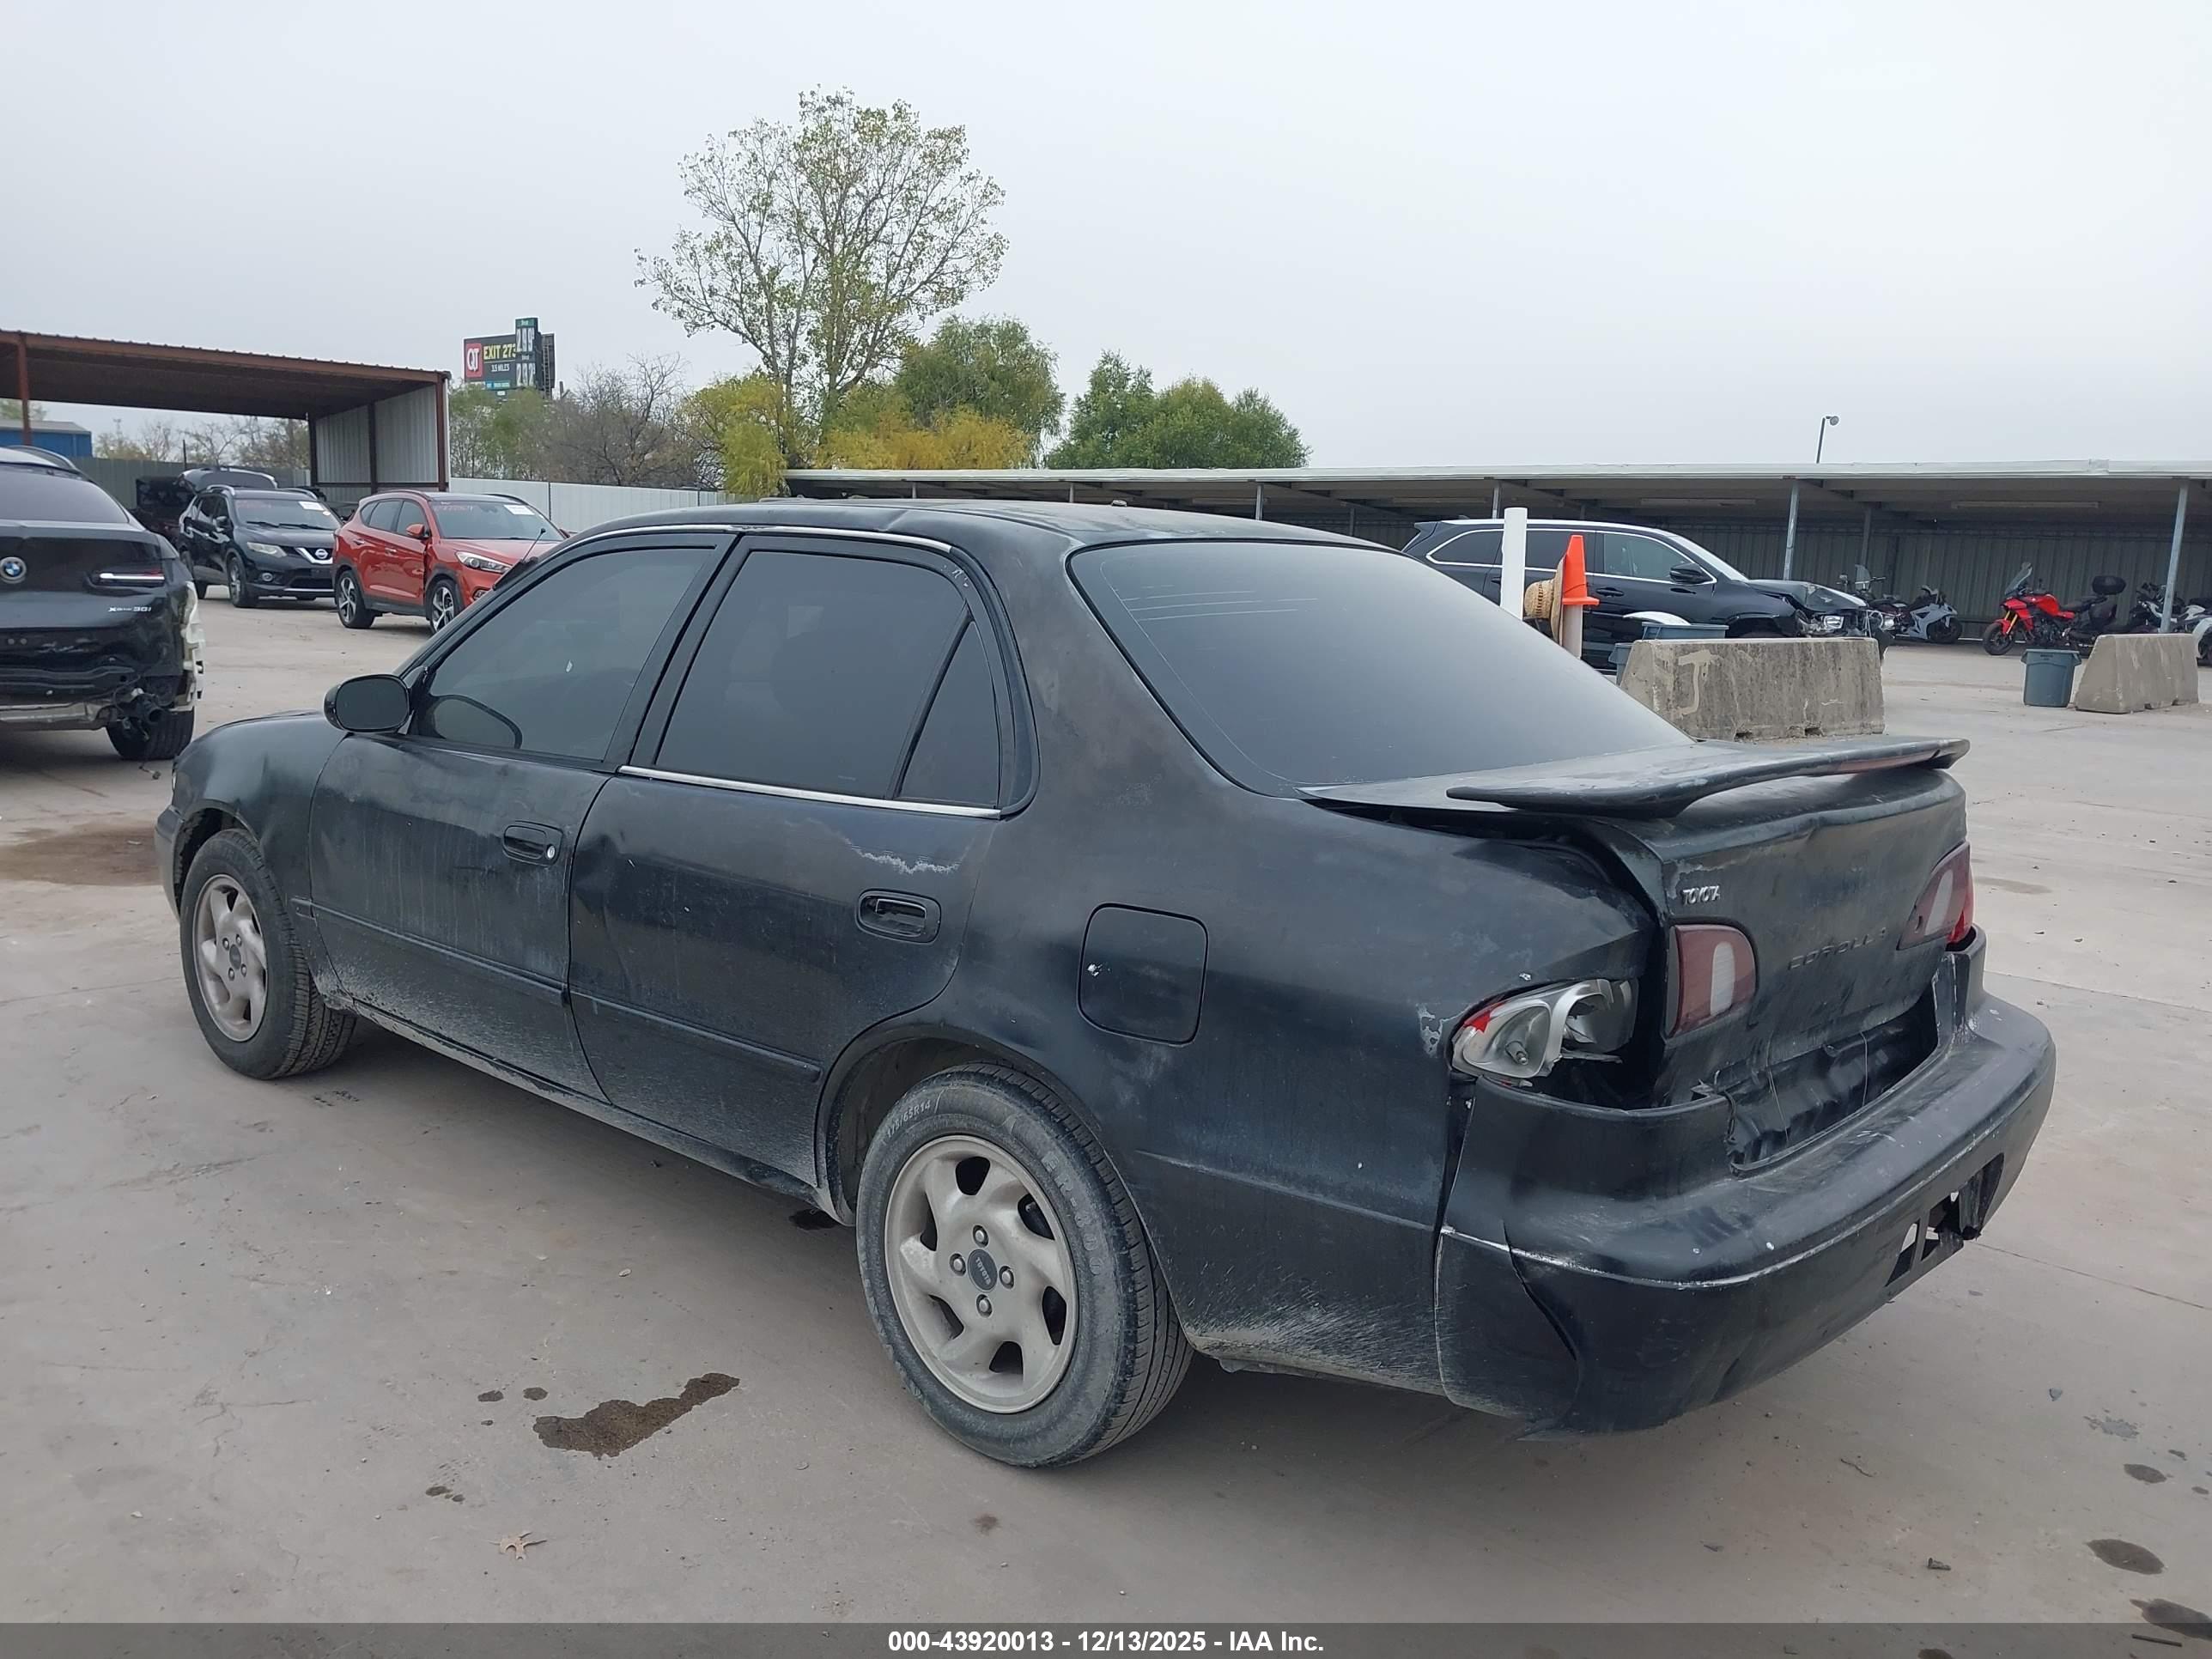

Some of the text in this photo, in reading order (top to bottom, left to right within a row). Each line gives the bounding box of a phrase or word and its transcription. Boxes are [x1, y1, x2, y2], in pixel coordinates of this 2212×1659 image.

[466, 348, 479, 372] QT
[483, 344, 501, 360] EXIT
[1683, 885, 1720, 905] TOYOTA
[975, 1256, 992, 1285] TOYOTA
